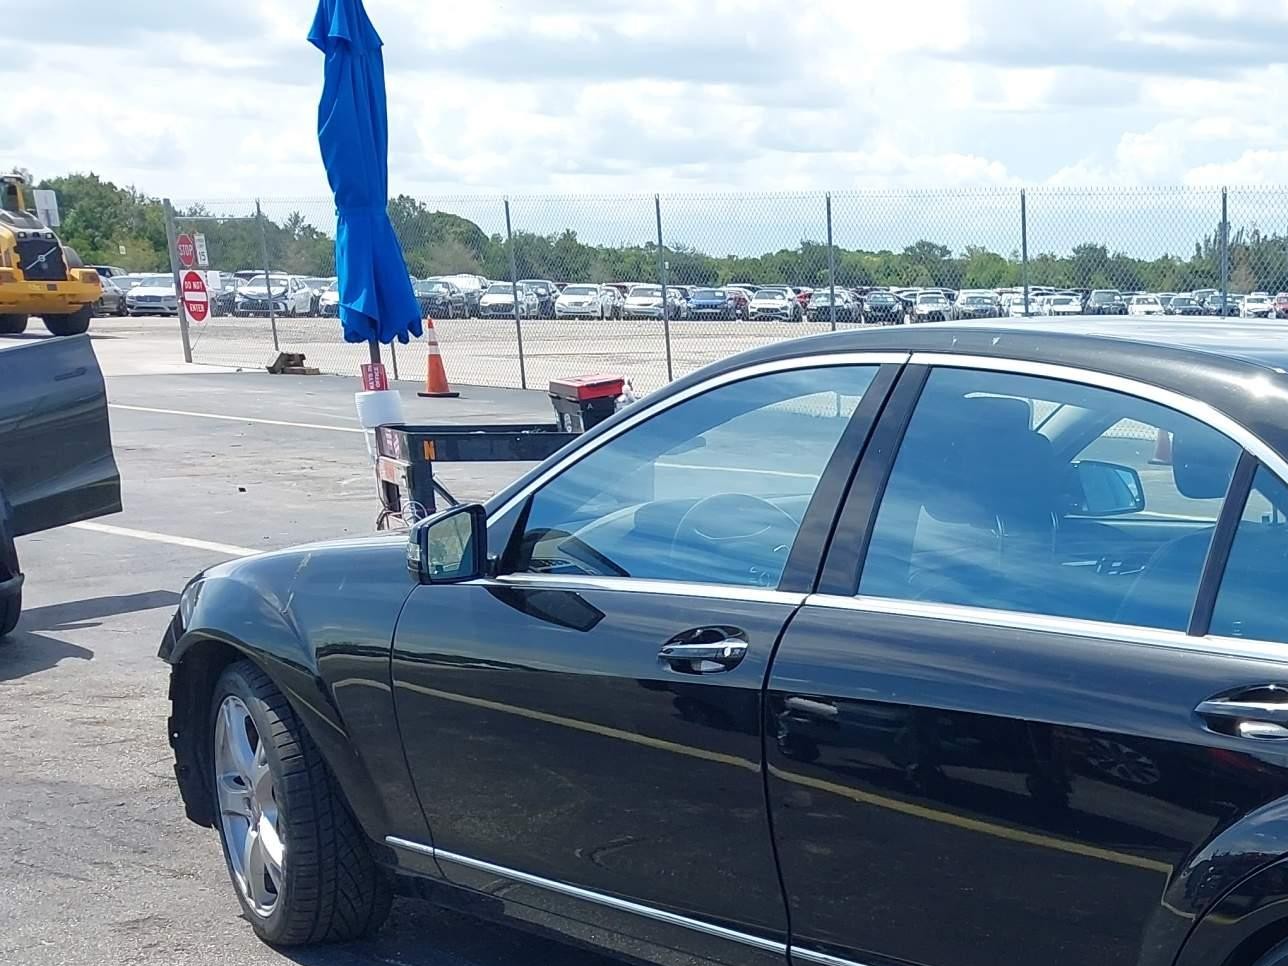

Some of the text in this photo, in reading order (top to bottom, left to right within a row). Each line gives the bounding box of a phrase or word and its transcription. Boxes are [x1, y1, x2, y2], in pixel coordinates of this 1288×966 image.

[178, 244, 193, 256] STOP
[199, 250, 206, 262] 15
[184, 281, 203, 290] DO NOT
[190, 304, 204, 312] ENTER
